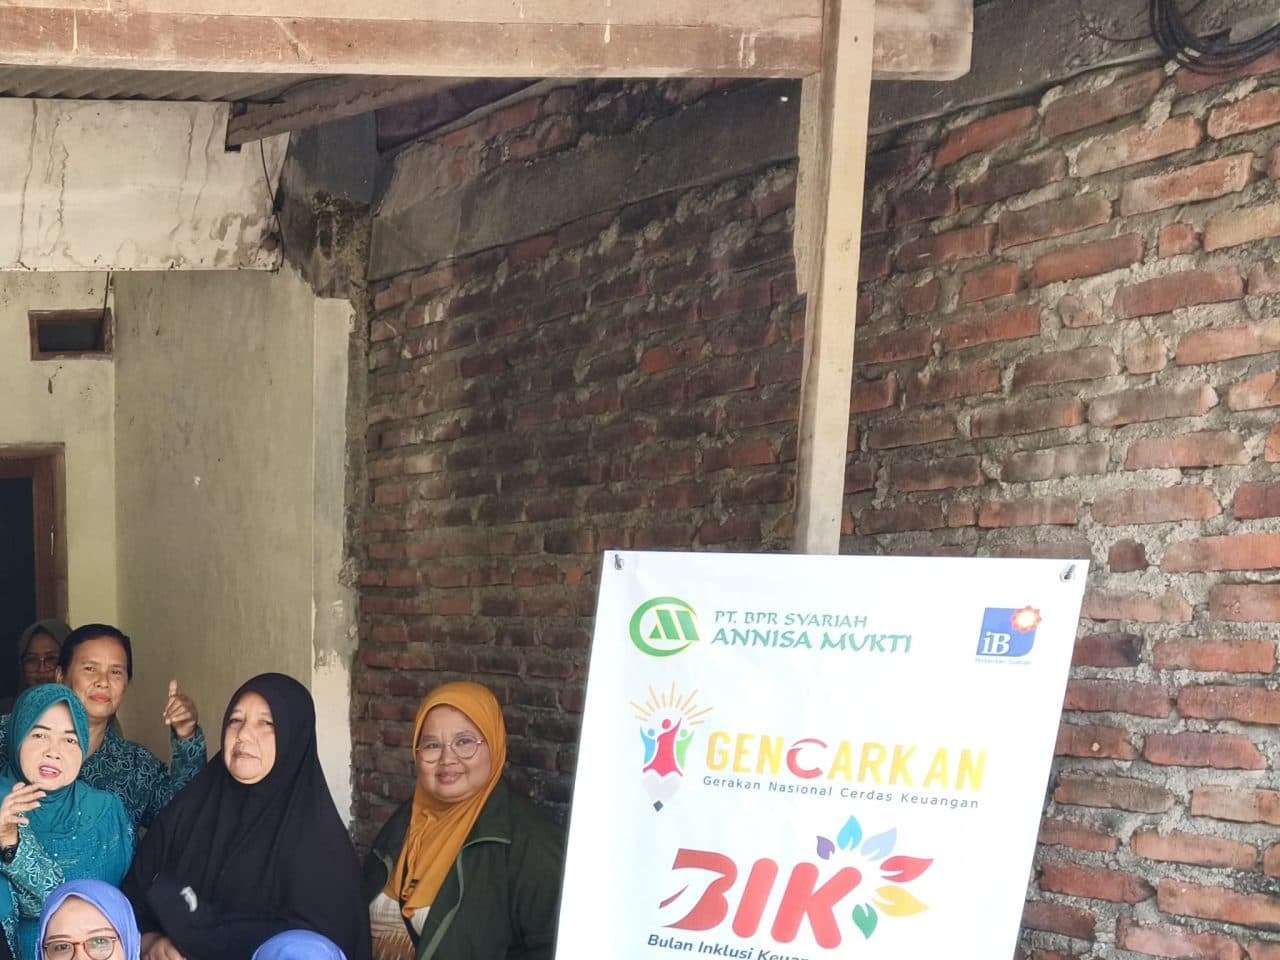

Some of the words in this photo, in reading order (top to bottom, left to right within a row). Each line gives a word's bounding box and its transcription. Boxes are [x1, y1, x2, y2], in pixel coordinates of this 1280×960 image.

[714, 610, 740, 625] PT.
[744, 611, 779, 626] BPR
[783, 613, 868, 629] SYARIAH
[711, 628, 813, 650] ANNISA
[820, 632, 913, 654] MUKTI
[980, 631, 1012, 656] iB
[705, 730, 988, 793] GENCARKAN
[702, 775, 762, 791] Gerakan
[768, 780, 834, 797] Nasional
[839, 786, 893, 803] Cerdas
[900, 792, 980, 810] Keuangan
[659, 847, 863, 950] BIK
[647, 934, 694, 954] Bulan
